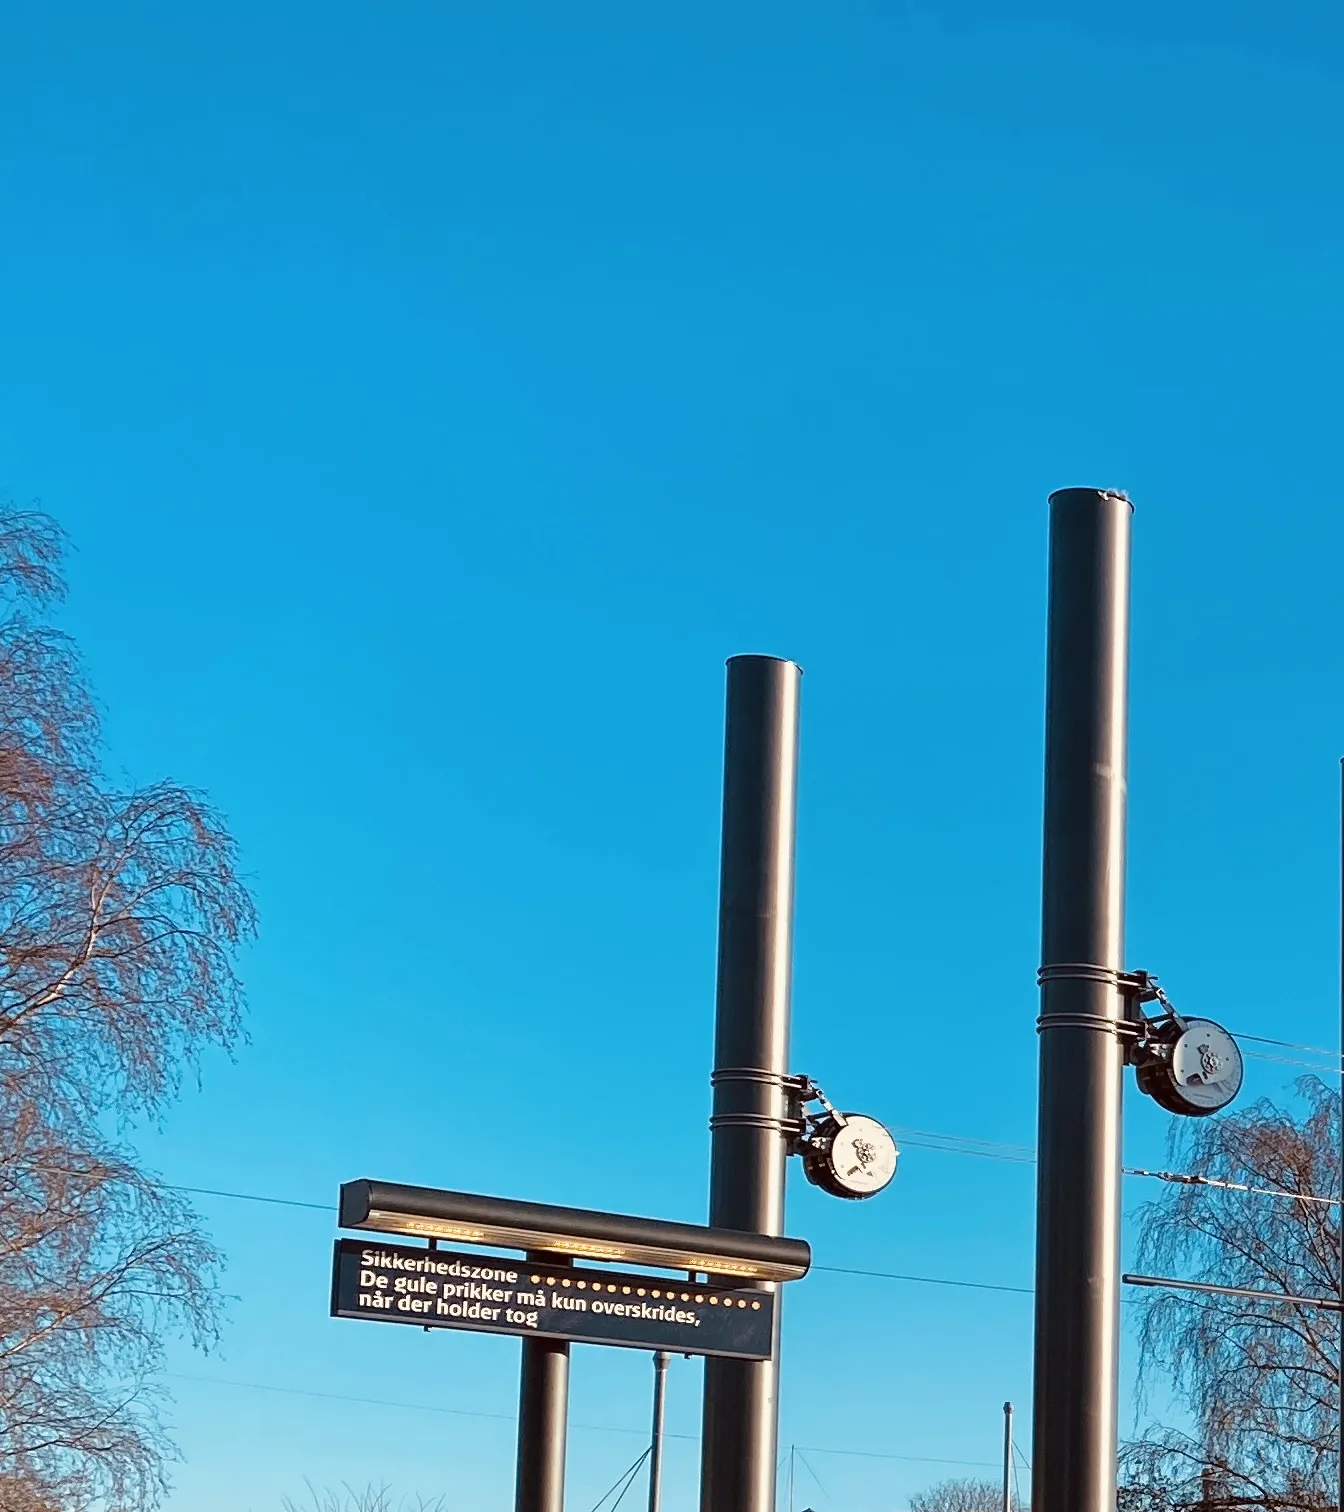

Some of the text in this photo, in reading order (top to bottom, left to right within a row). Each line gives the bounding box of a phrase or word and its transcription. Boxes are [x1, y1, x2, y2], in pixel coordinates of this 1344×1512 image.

[360, 1249, 518, 1283] Sikkerhedszone
[359, 1290, 538, 1328] når der holder tog
[360, 1270, 701, 1327] De gule prikker må kun overskrides,
